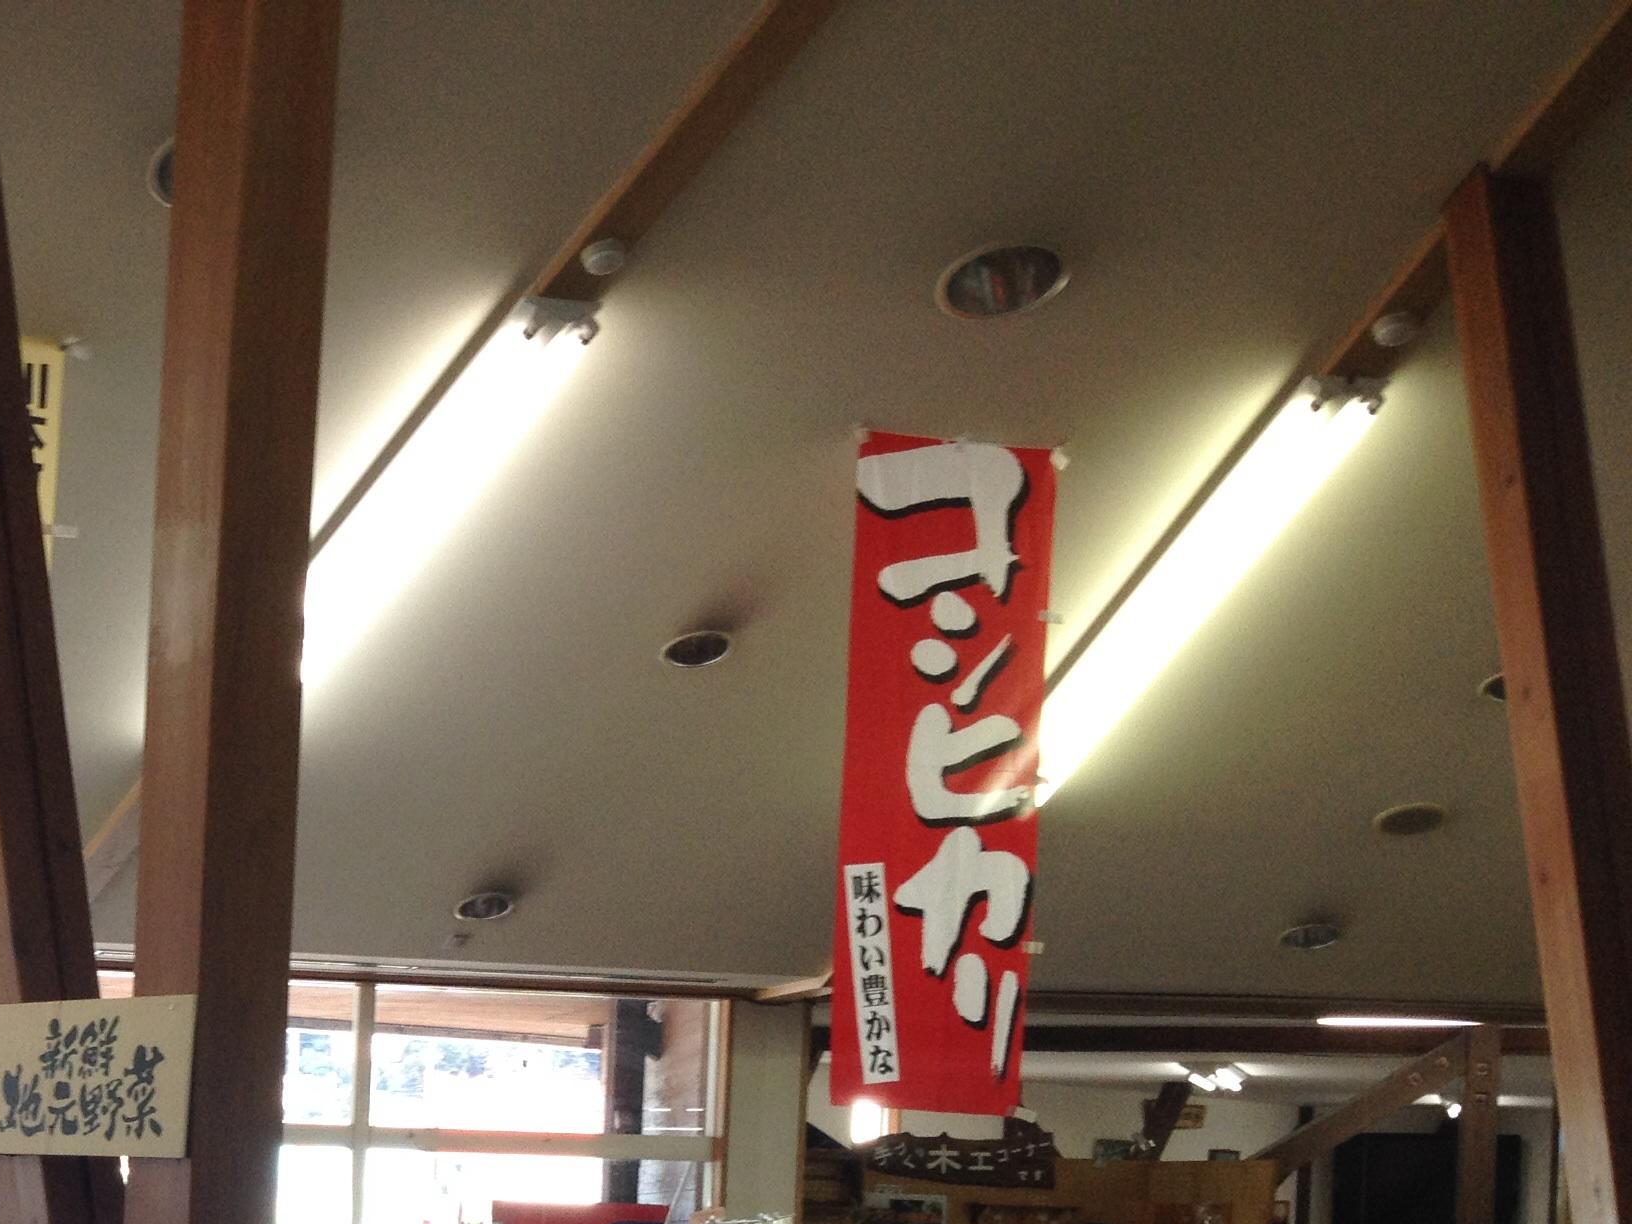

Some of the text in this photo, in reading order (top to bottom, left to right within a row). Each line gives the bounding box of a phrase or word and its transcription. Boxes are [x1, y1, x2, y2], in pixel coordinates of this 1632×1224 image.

[857, 443, 1029, 1078] コシヒカリ
[39, 1016, 121, 1079] 新鮮
[852, 872, 896, 1077] 味わい豊かな
